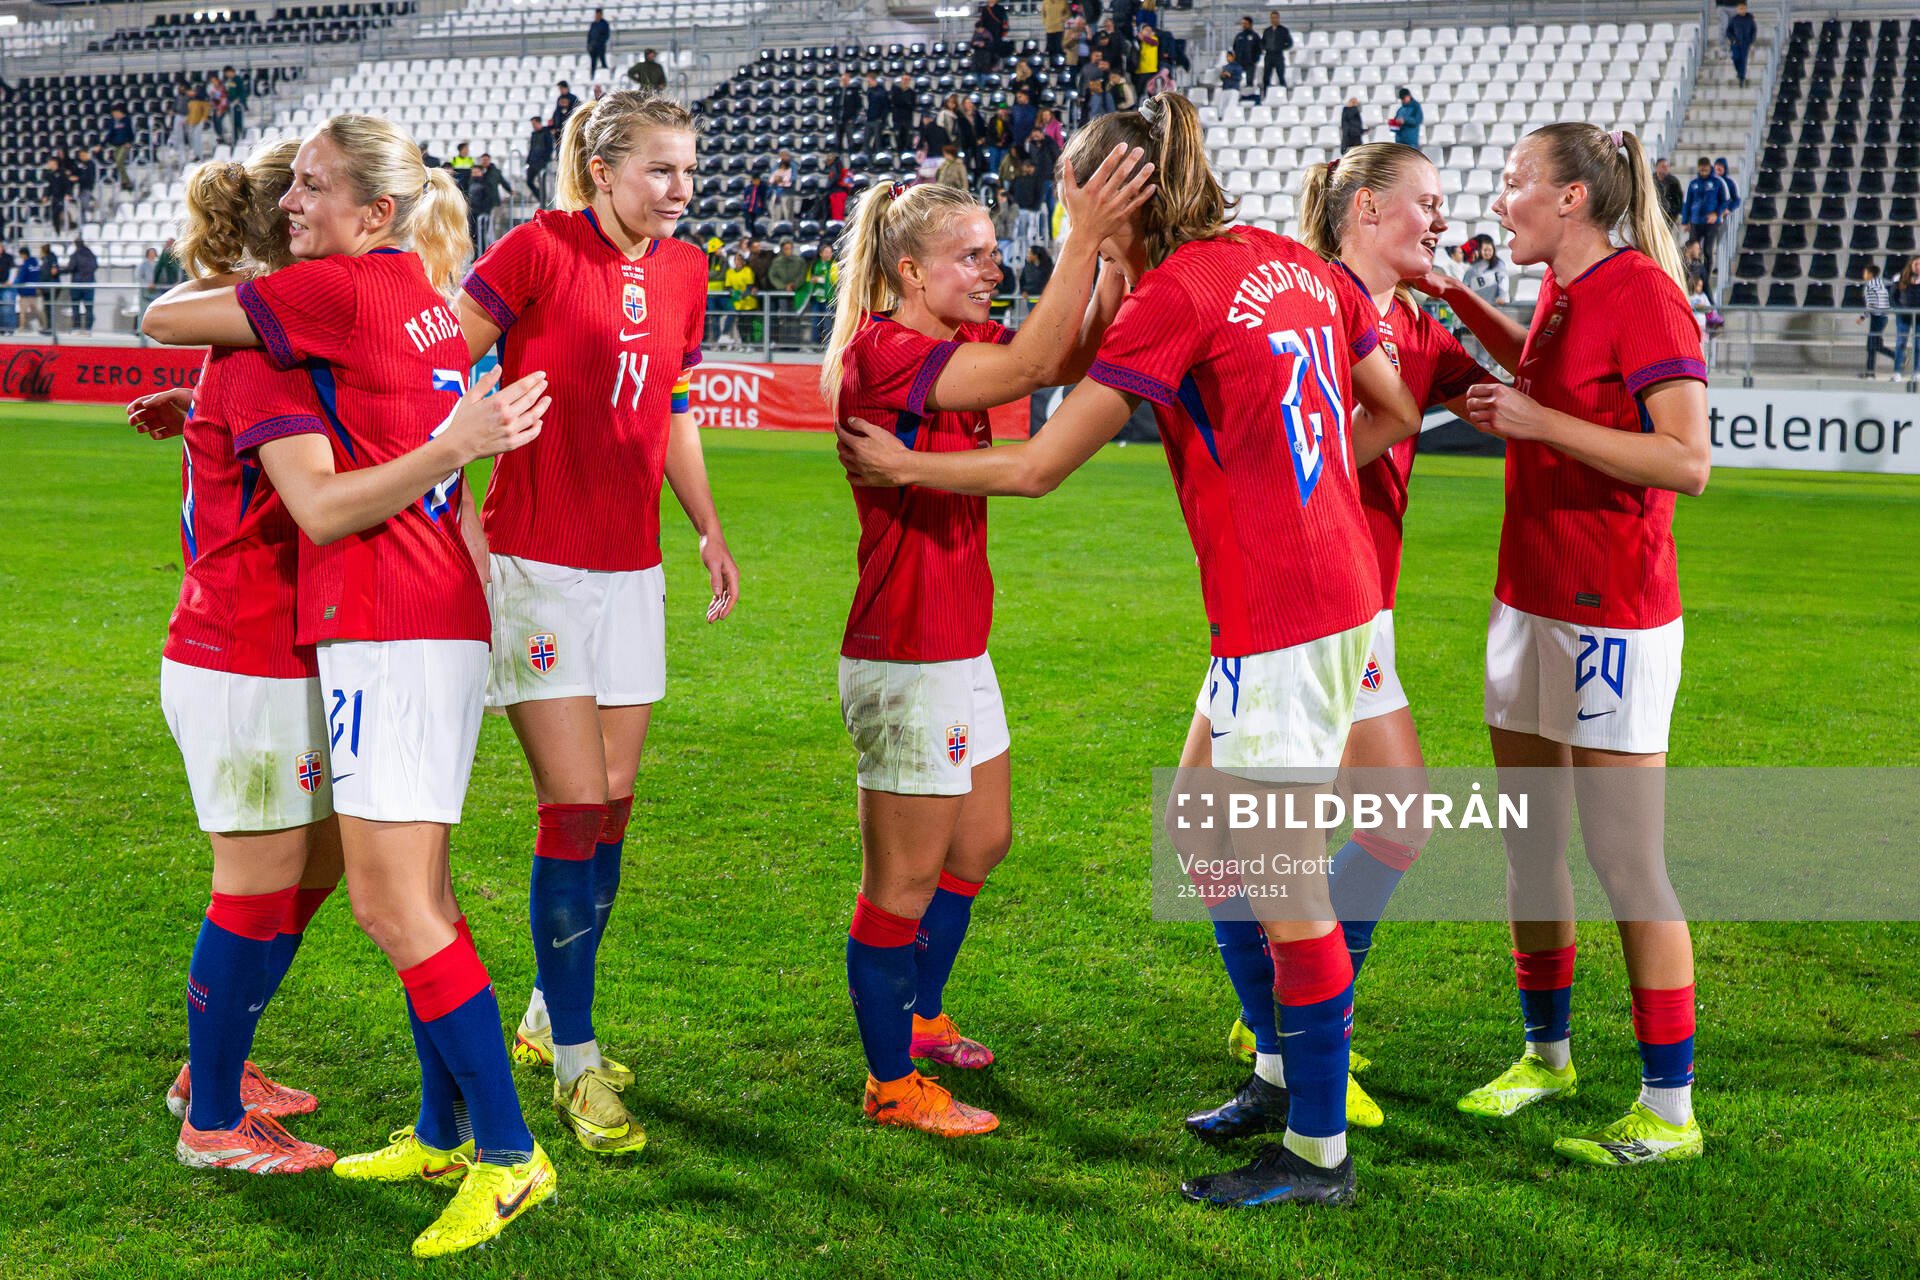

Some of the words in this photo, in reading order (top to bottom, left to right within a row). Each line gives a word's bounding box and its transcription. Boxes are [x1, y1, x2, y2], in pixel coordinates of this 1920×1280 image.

[76, 365, 142, 385] ZERO
[611, 351, 649, 411] 14
[1267, 325, 1350, 507] 24
[1708, 404, 1913, 454] telenor
[1575, 634, 1628, 700] 20
[329, 689, 363, 758] 21
